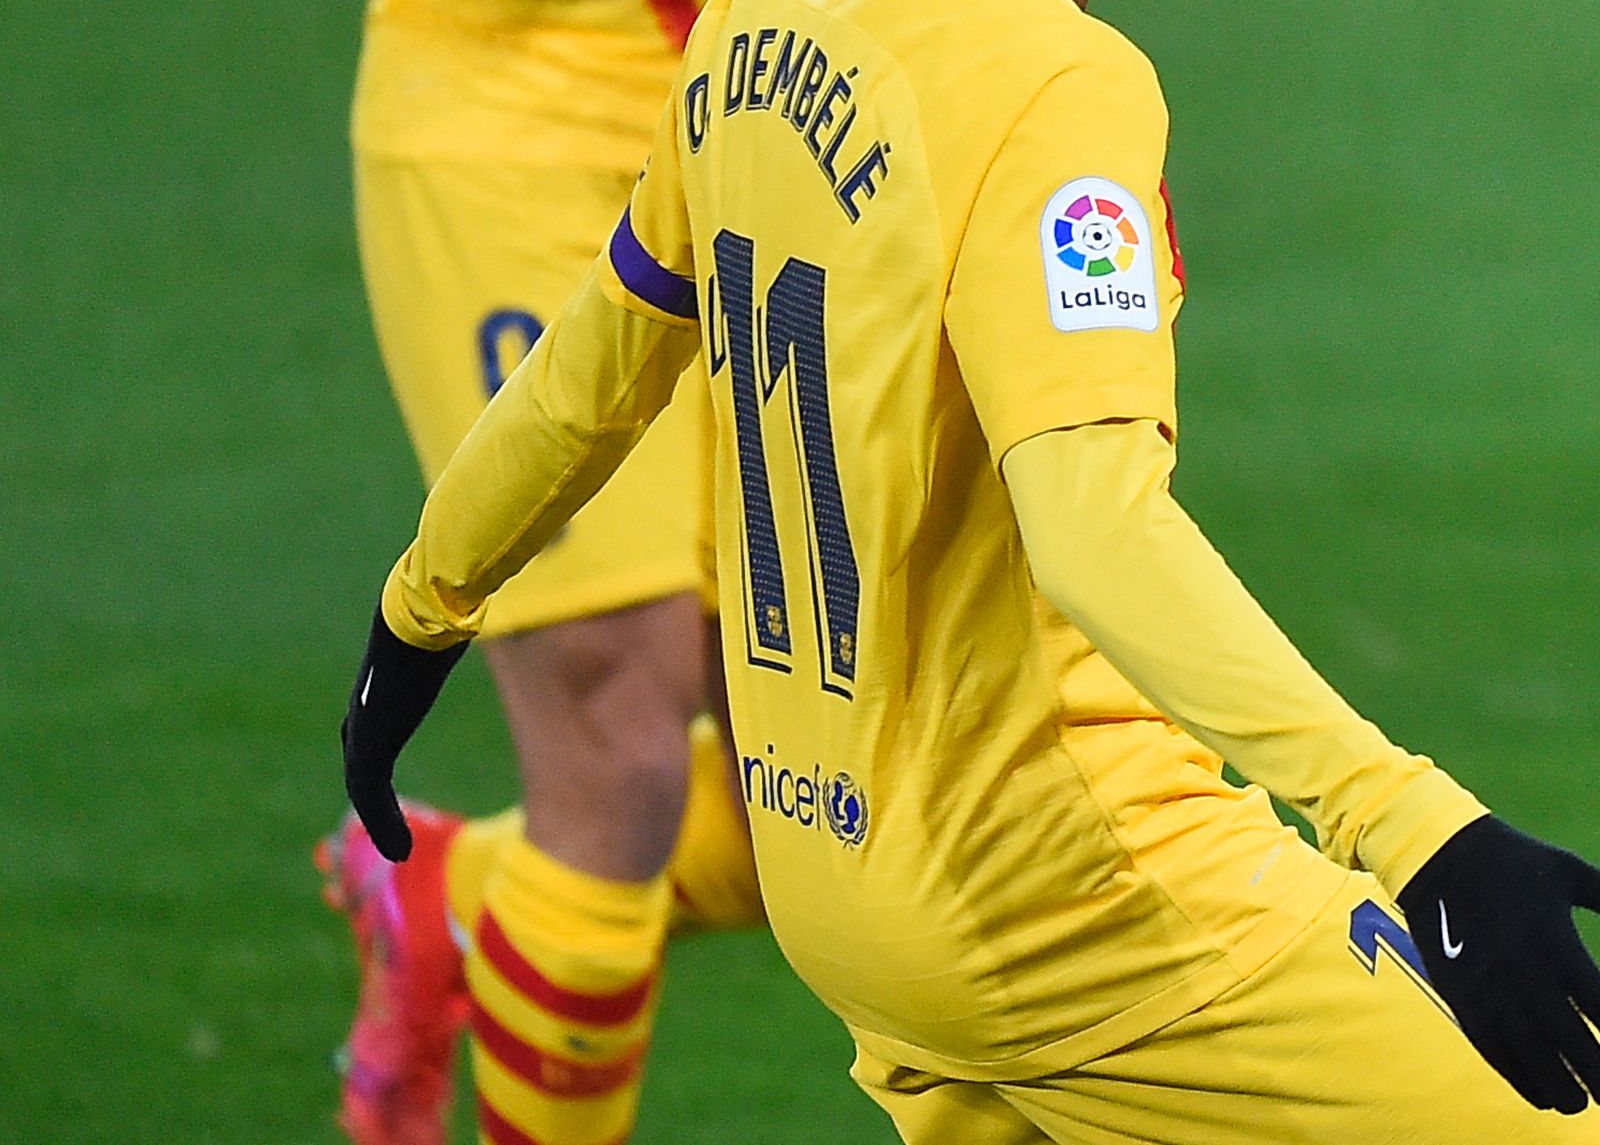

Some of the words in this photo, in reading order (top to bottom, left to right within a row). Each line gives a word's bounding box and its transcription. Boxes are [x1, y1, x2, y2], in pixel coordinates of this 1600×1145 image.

[723, 28, 891, 225] DEMBÉLÉ
[1060, 284, 1147, 310] LaLiga
[708, 228, 861, 702] 11
